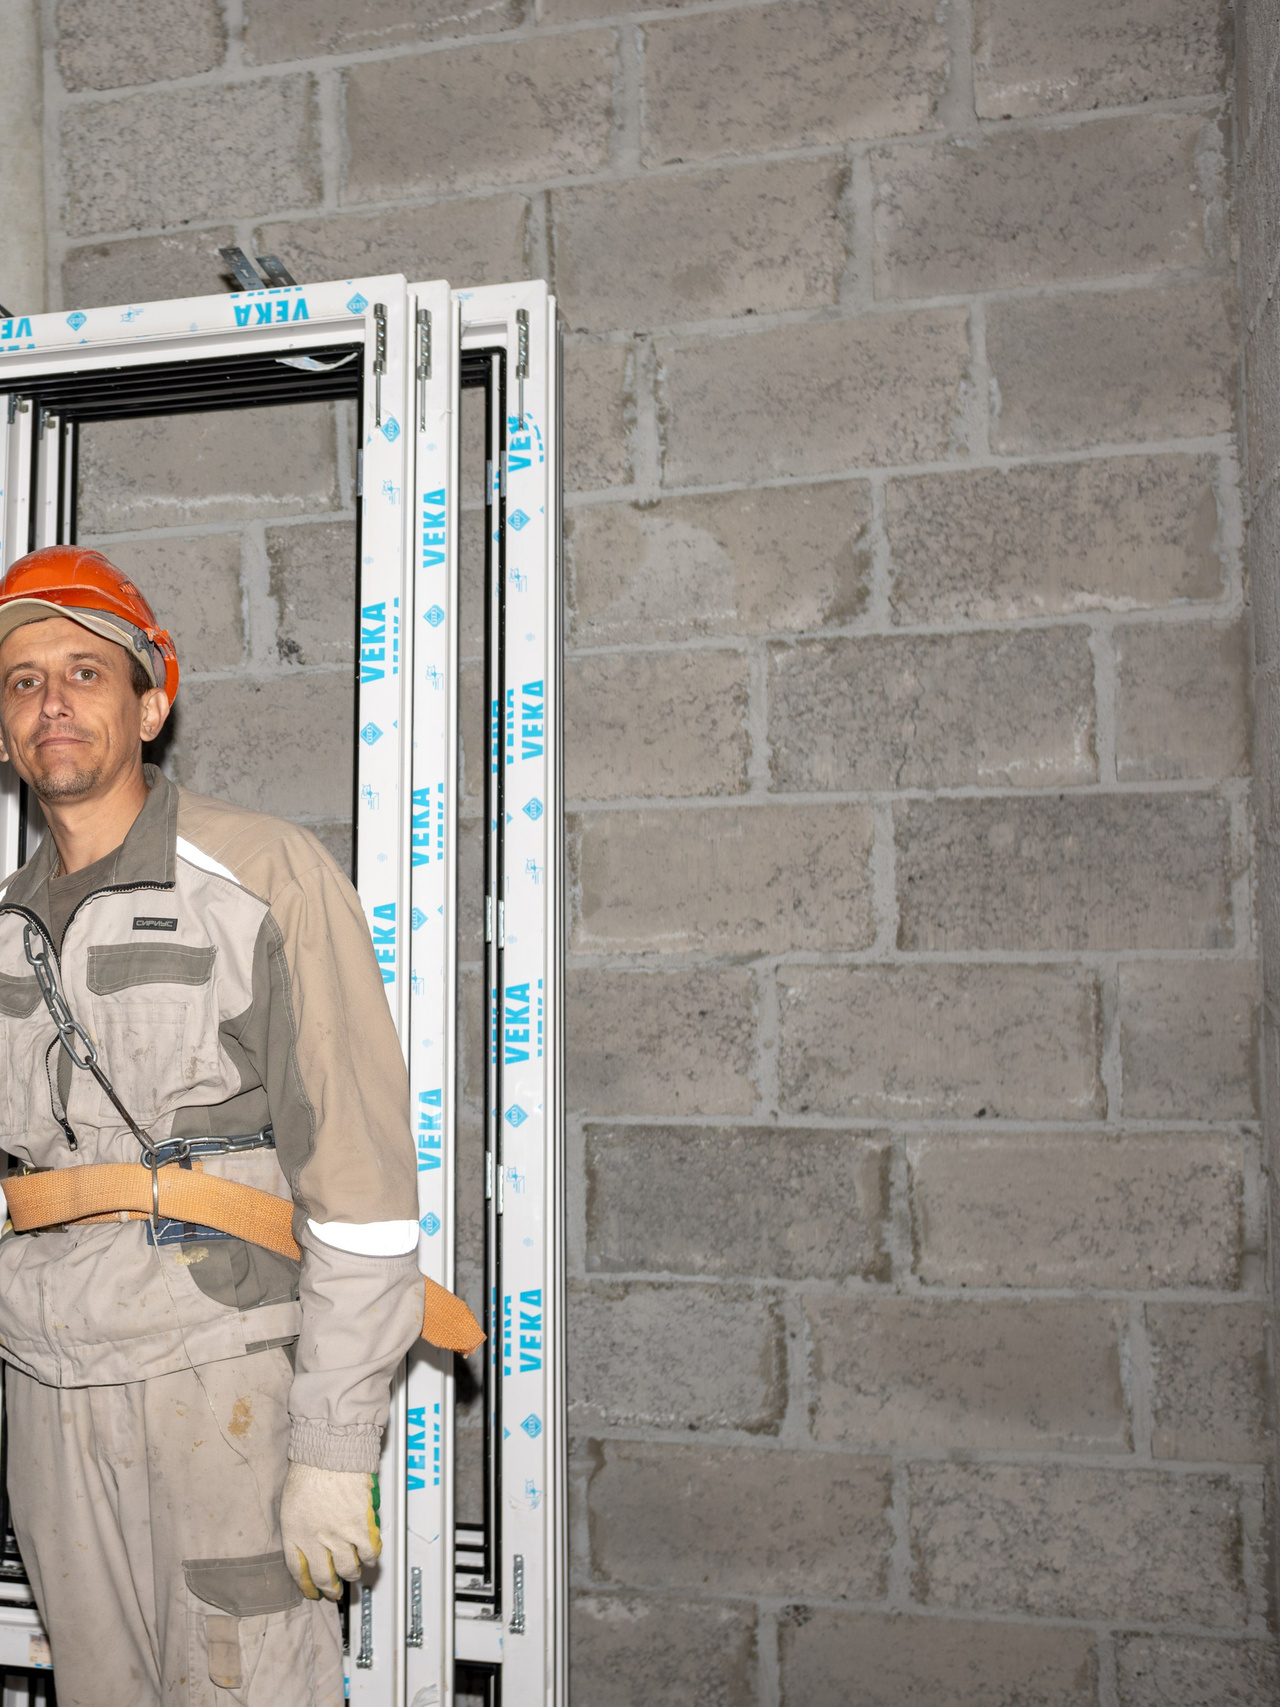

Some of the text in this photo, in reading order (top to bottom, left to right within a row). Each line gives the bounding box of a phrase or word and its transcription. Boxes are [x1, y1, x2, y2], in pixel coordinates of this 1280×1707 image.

[234, 298, 309, 327] VEKA
[423, 489, 445, 567] VEKA
[361, 602, 385, 683] VEKA
[522, 680, 543, 760] VEKA
[411, 788, 429, 867] VEKA
[373, 903, 395, 984] VEKA
[505, 983, 530, 1064] VEKA
[418, 1089, 441, 1171] VEKA
[520, 1289, 541, 1372] VEKA
[406, 1407, 426, 1490] VEKA
